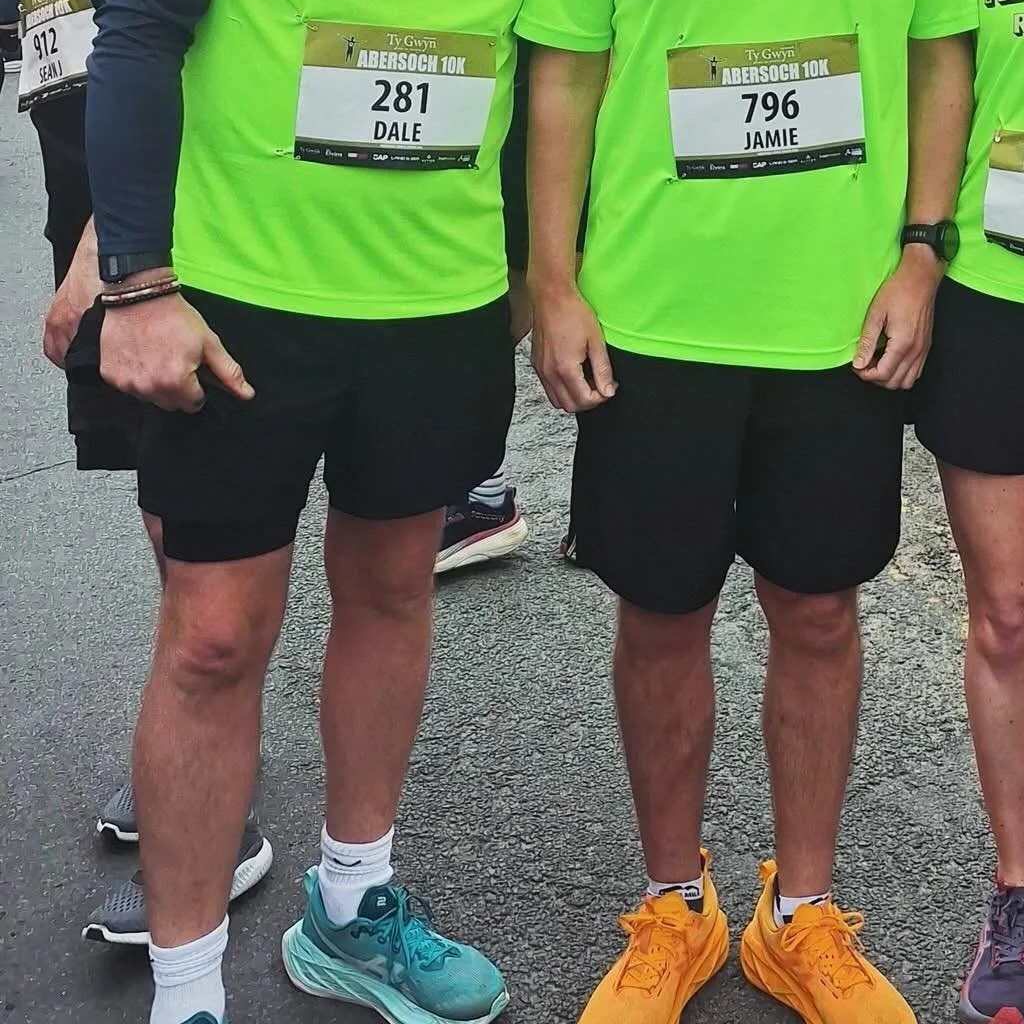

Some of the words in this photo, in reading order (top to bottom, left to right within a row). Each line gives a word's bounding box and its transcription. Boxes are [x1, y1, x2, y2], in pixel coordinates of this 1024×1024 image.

[33, 27, 58, 61] 912
[387, 34, 402, 48] Ty
[404, 35, 436, 51] Gwyn
[745, 49, 759, 61] Ty
[761, 46, 795, 62] Gwyn
[40, 62, 58, 84] SEAN
[58, 60, 63, 76] J
[356, 50, 437, 73] ABERSOCH
[440, 56, 466, 75] 10K
[722, 63, 800, 85] ABERSOCH
[802, 59, 830, 77] 10K
[371, 79, 430, 114] 281
[741, 89, 799, 123] 796
[374, 121, 422, 142] DALE
[744, 128, 799, 150] JAMIE
